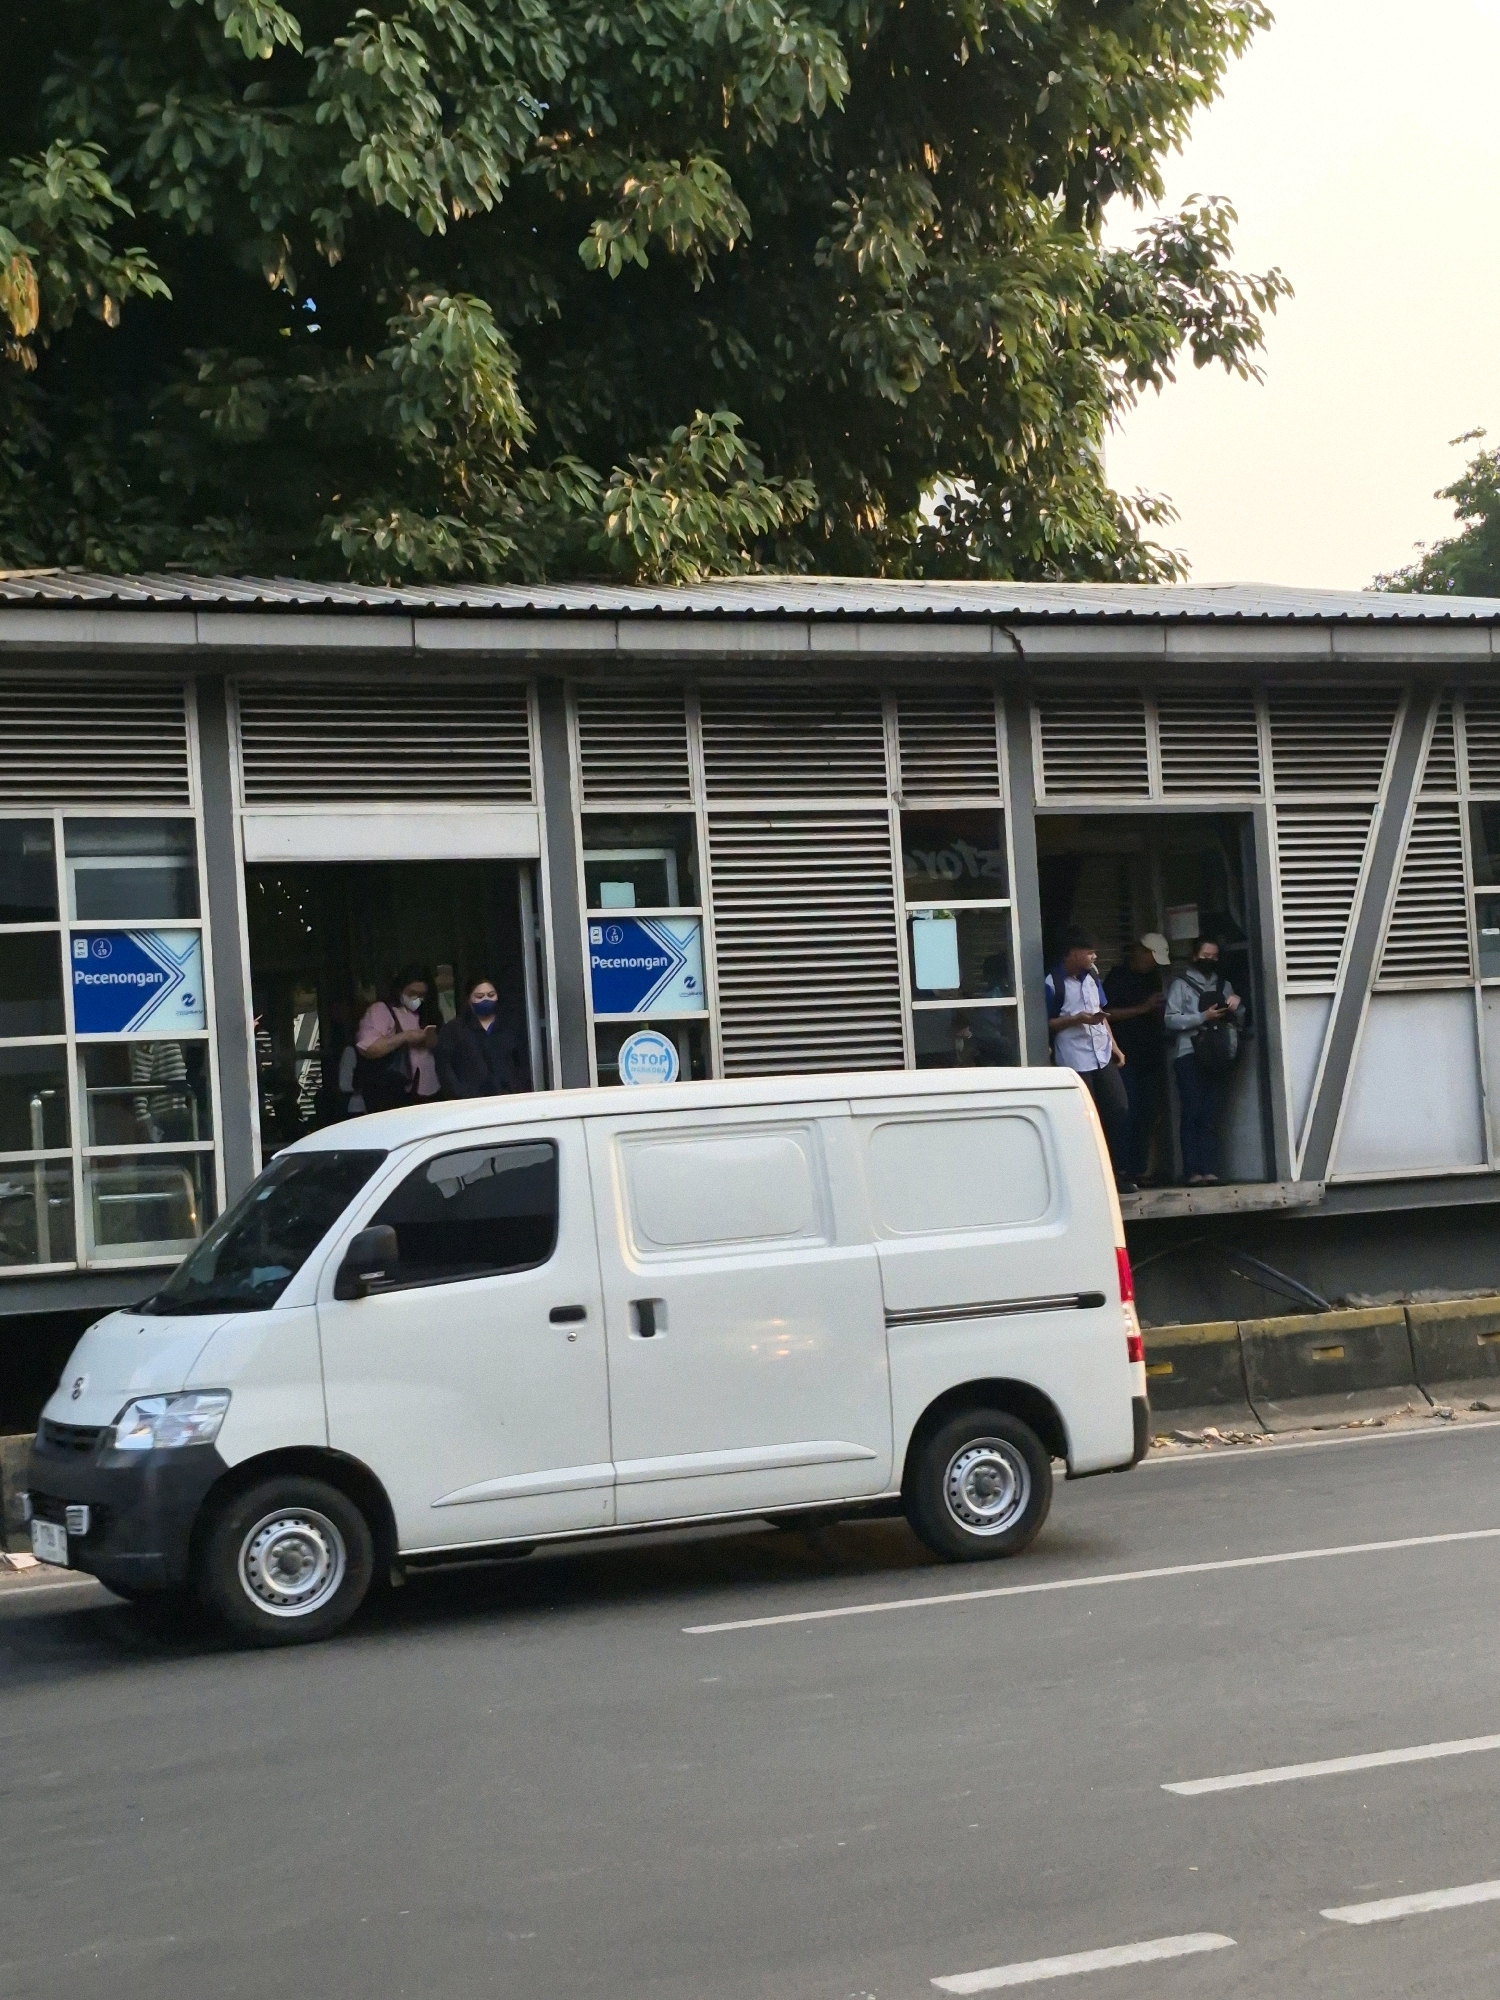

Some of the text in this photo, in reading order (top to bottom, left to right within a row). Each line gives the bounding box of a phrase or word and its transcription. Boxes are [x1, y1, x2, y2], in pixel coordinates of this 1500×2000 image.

[591, 956, 668, 970] Pecenongan
[74, 971, 163, 987] Pecenongan
[630, 1054, 668, 1065] STOP
